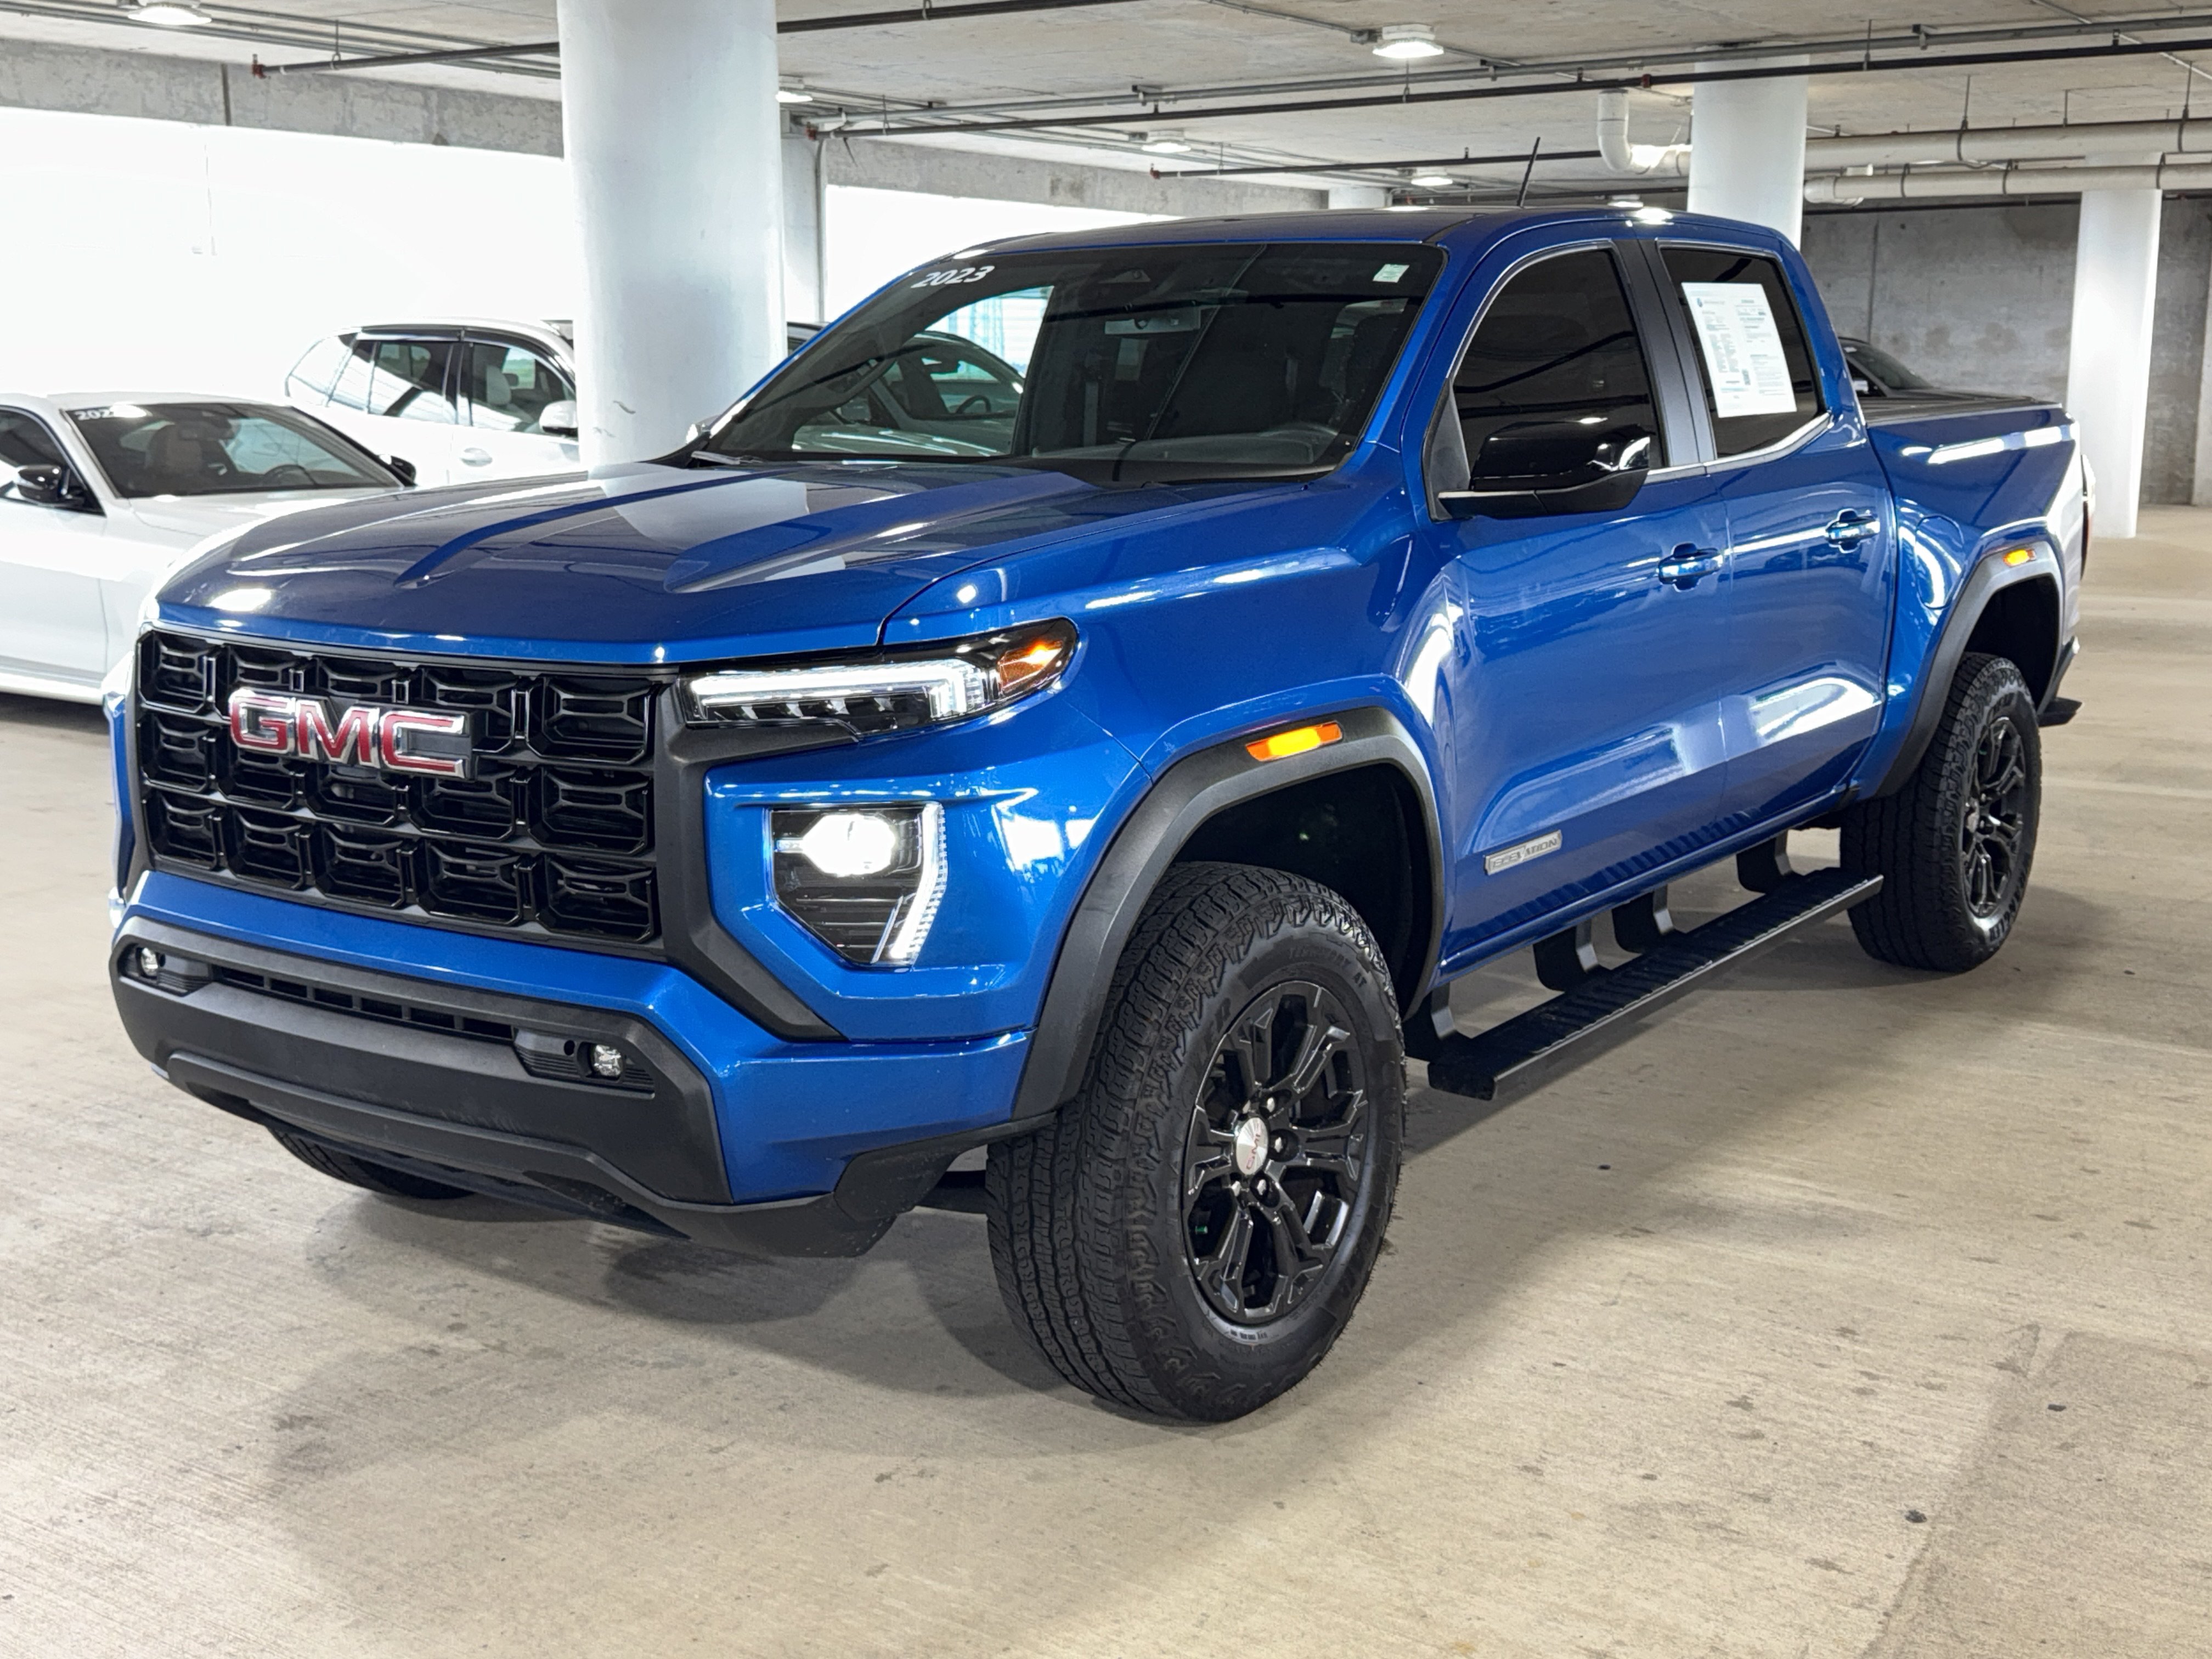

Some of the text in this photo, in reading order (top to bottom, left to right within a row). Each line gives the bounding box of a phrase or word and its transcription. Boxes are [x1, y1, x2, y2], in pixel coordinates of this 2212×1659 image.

[911, 266, 995, 288] 2023
[75, 409, 115, 420] 202
[228, 687, 465, 778] GMC
